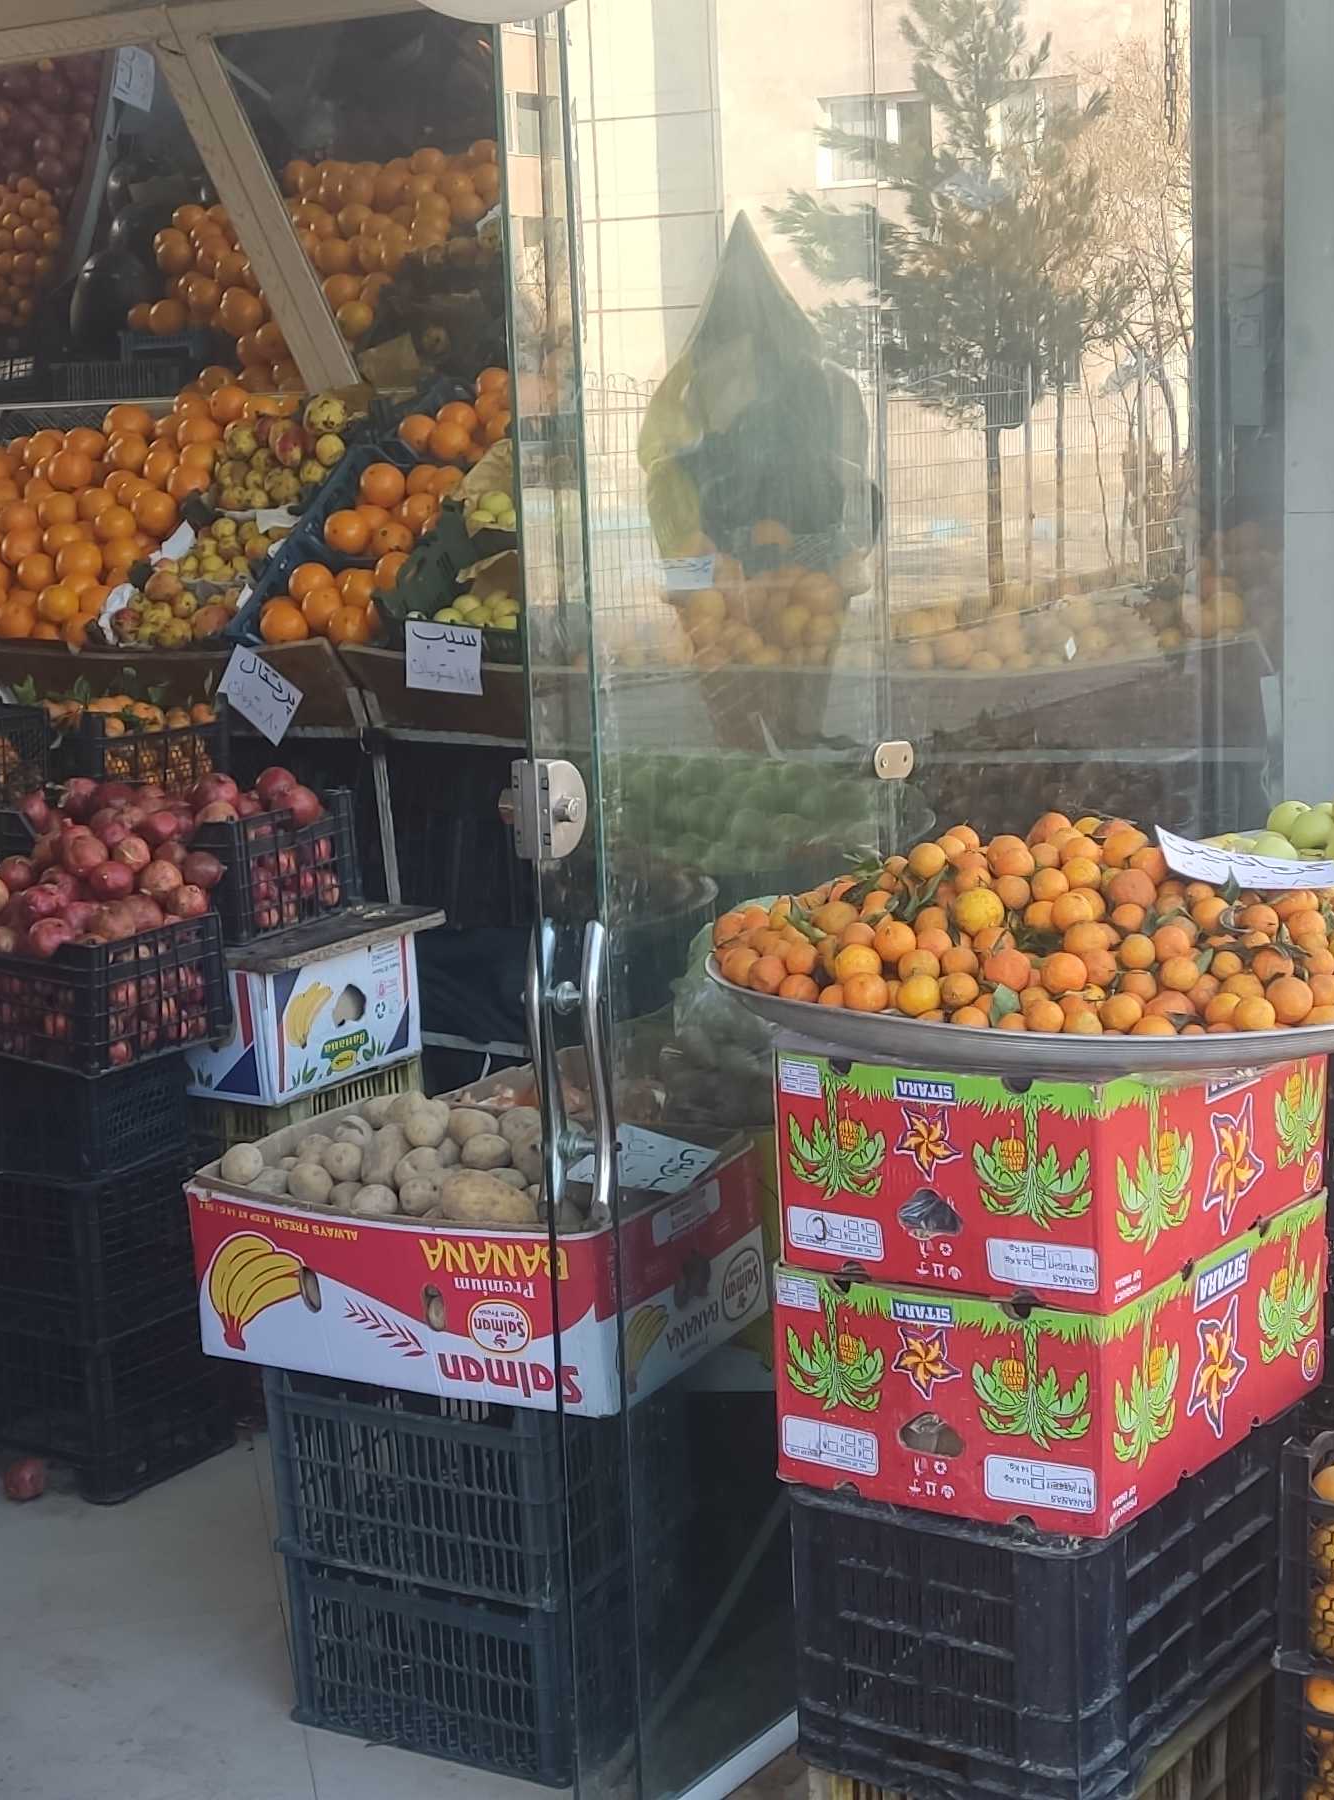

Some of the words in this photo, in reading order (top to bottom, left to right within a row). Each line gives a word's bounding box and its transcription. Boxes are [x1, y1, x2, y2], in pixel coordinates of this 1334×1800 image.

[412, 628, 476, 652] سیب
[240, 657, 294, 715] پرتقال
[898, 1081, 953, 1100] SITARA
[274, 1216, 309, 1233] FRESH
[312, 1225, 358, 1240] ALWAYS
[419, 1239, 569, 1280] BANANA
[725, 1264, 758, 1300] Salman
[1200, 1253, 1246, 1300] SITARA
[454, 1278, 535, 1298] Premium
[896, 1302, 951, 1322] SITARA
[474, 1318, 525, 1338] Salman
[437, 1354, 582, 1403] Salman
[1050, 1495, 1092, 1509] BANANAS
